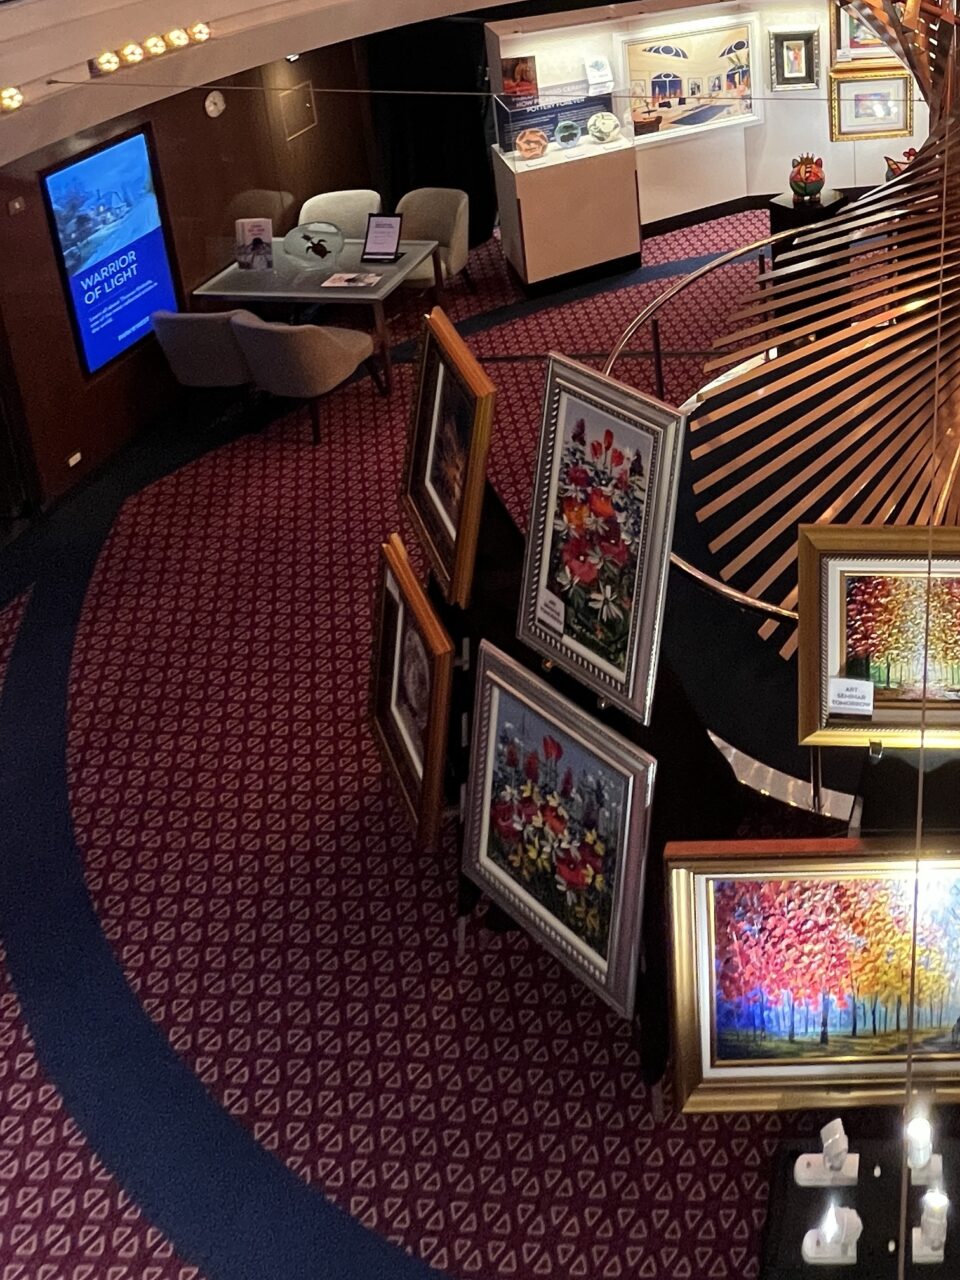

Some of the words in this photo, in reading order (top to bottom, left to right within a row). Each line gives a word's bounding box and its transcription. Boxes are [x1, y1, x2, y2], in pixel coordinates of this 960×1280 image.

[526, 103, 555, 113] POTTERY
[80, 250, 137, 290] WARRIOR
[84, 285, 102, 304] OF
[104, 263, 138, 293] LIGHT
